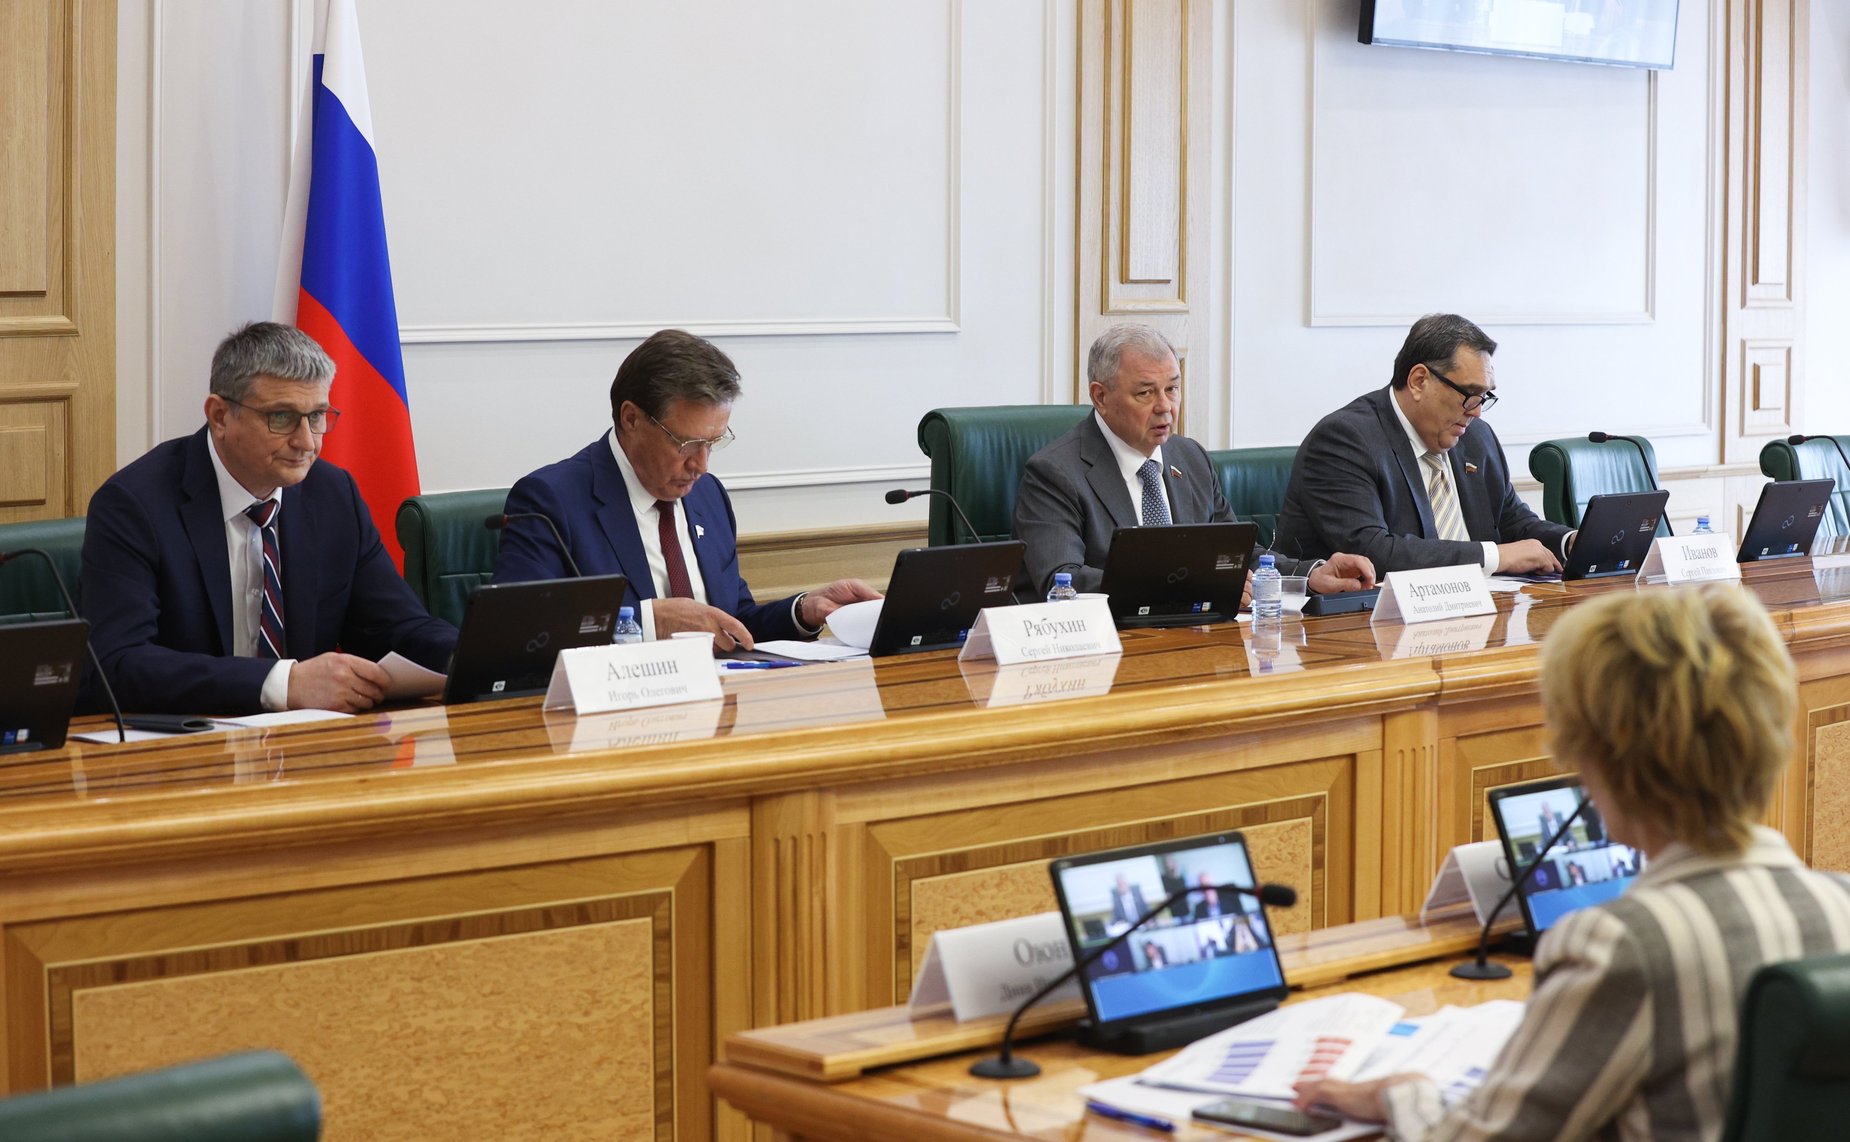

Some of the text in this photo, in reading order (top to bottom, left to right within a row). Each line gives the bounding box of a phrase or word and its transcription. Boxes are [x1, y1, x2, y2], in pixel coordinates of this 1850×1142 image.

[1681, 544, 1719, 561] Иванов
[1408, 581, 1472, 601] Артамонов
[1023, 617, 1087, 640] Рябухин
[1021, 645, 1050, 660] Сергей
[607, 660, 679, 681] Алешин
[608, 685, 688, 704] Игорь Олегович
